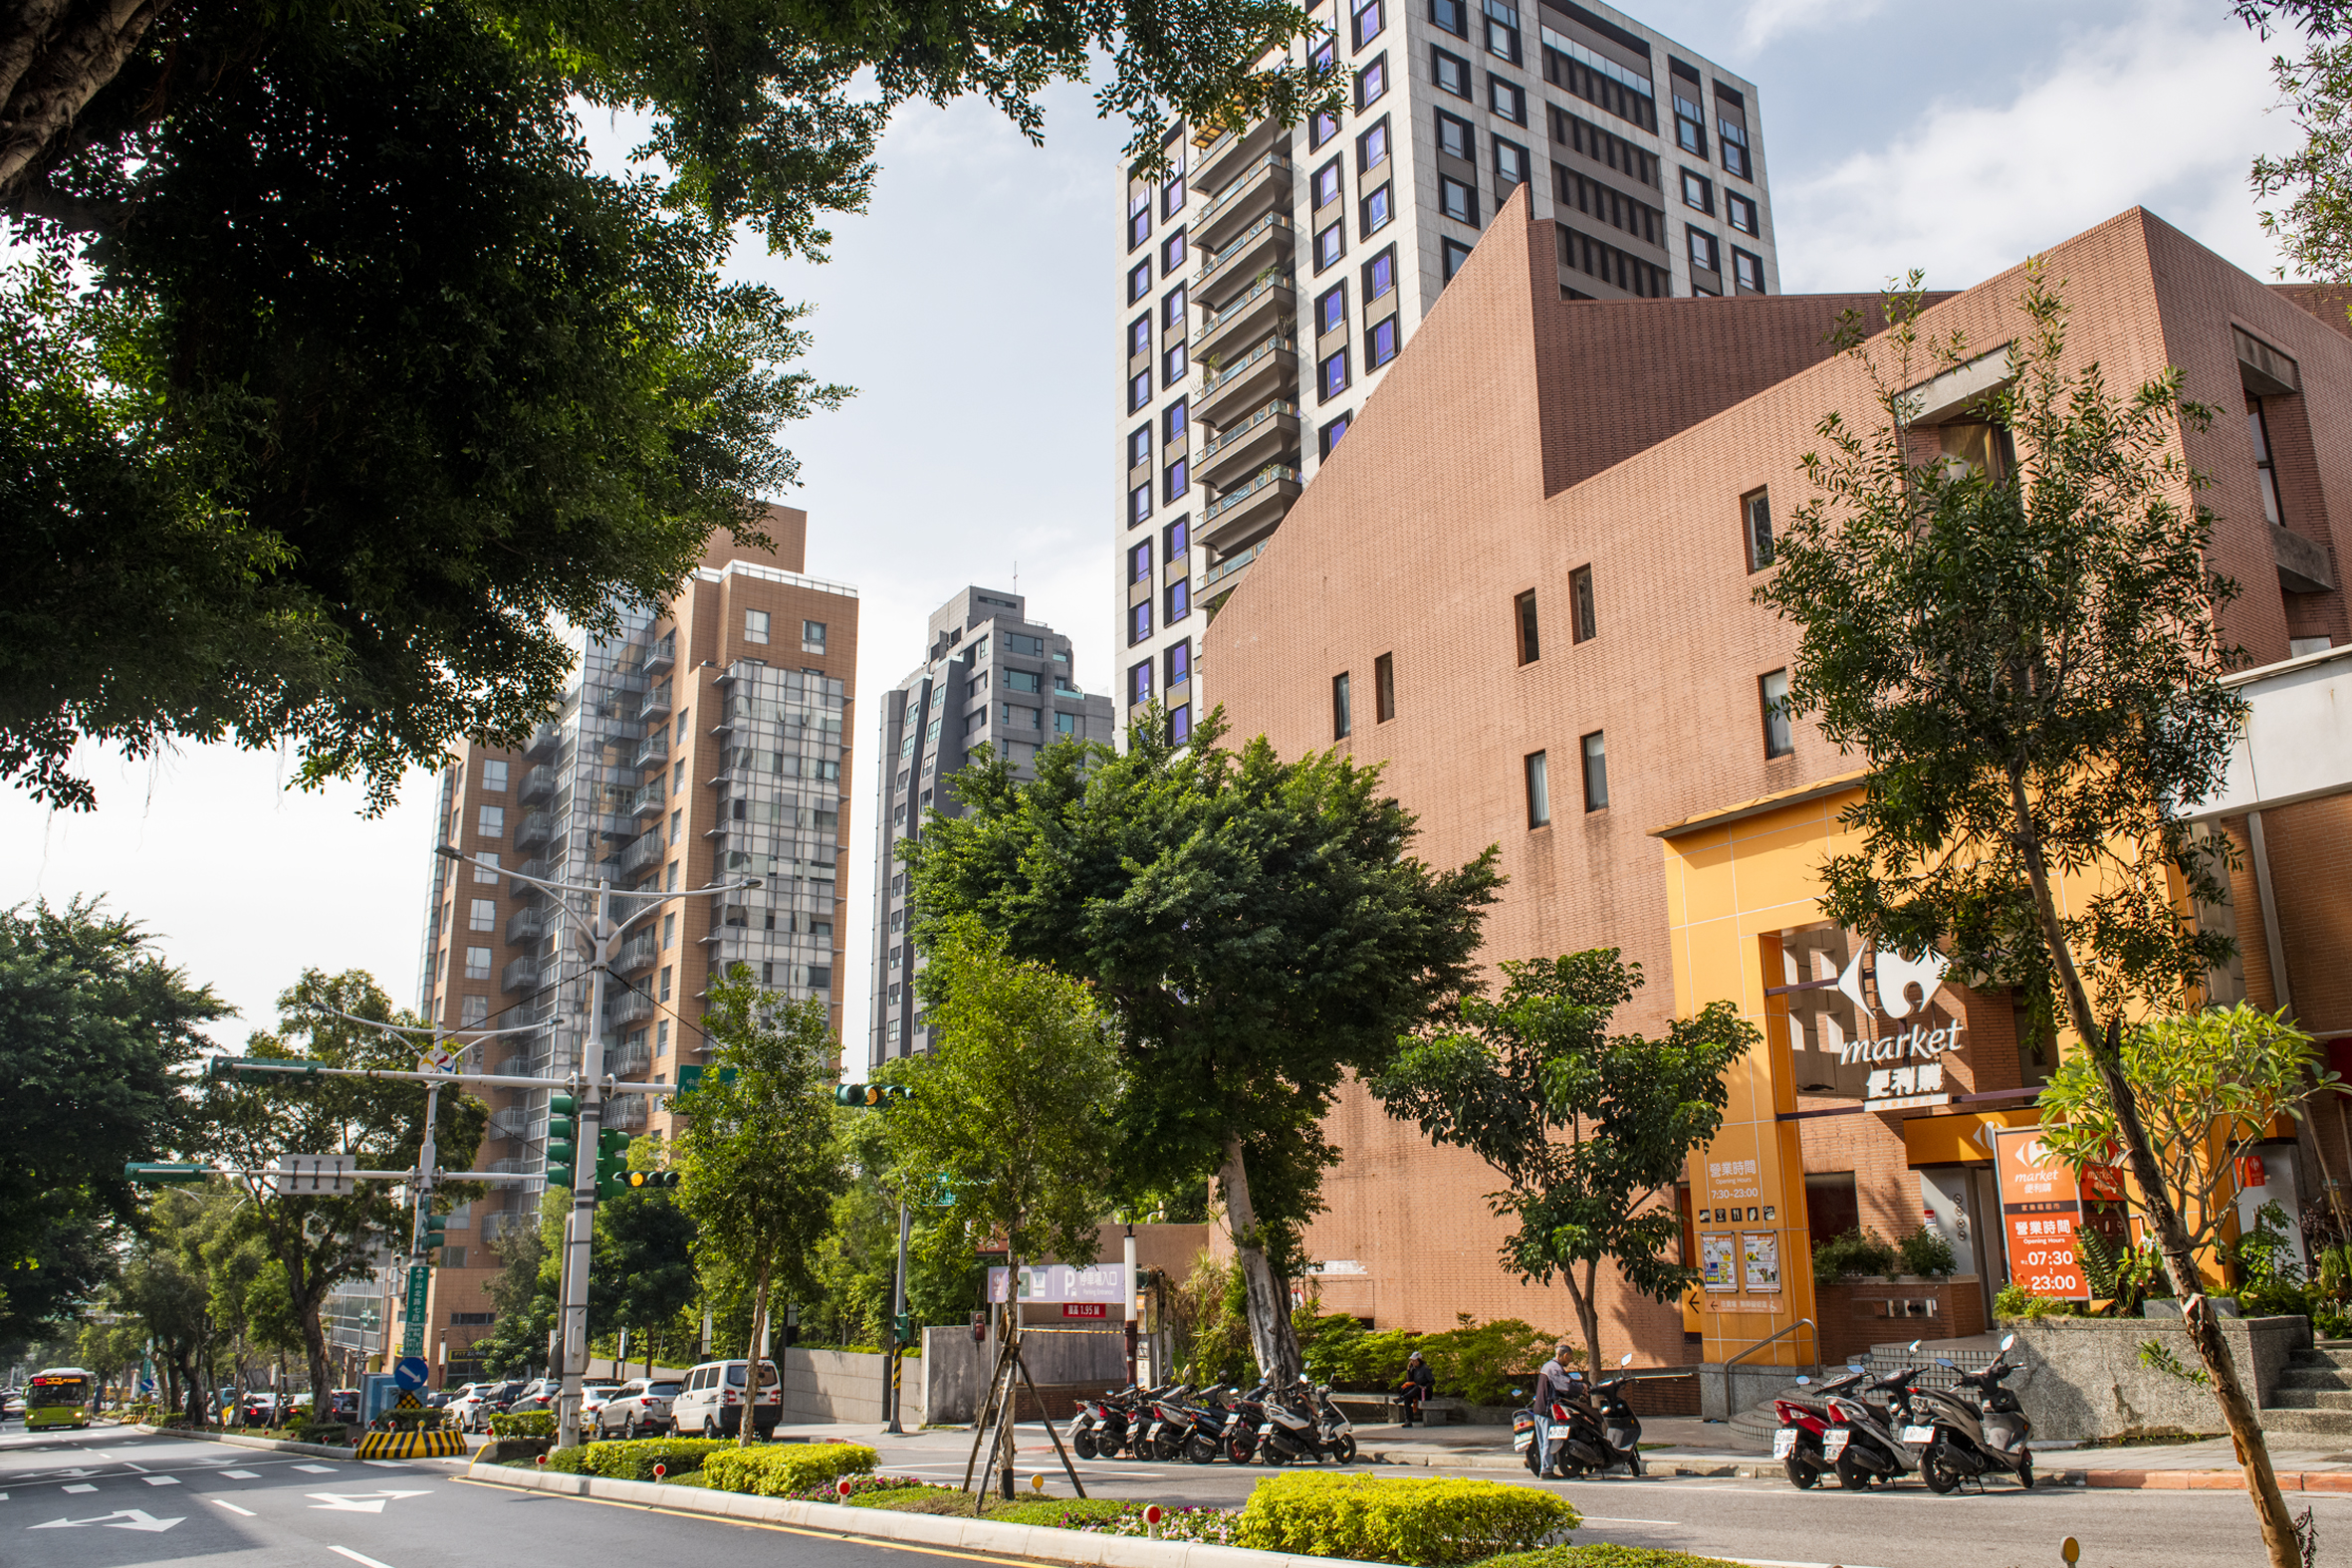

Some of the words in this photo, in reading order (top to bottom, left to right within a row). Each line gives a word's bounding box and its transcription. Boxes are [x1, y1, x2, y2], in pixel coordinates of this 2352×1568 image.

[1840, 1018, 1964, 1065] market
[1866, 1062, 1944, 1099] 便利購
[1709, 1159, 1756, 1178] 營業時間
[2014, 1169, 2058, 1183] market
[2024, 1183, 2051, 1194] 便利購
[2021, 1203, 2060, 1212] 家樂福超市
[2014, 1220, 2070, 1235] 營業時間
[2027, 1250, 2073, 1265] 07:30
[1064, 1269, 1075, 1296] P
[1079, 1271, 1117, 1286] 停車場入口
[2031, 1275, 2076, 1290] 23:00
[411, 1272, 424, 1322] 中山北路七段
[1080, 1305, 1093, 1315] 1.95
